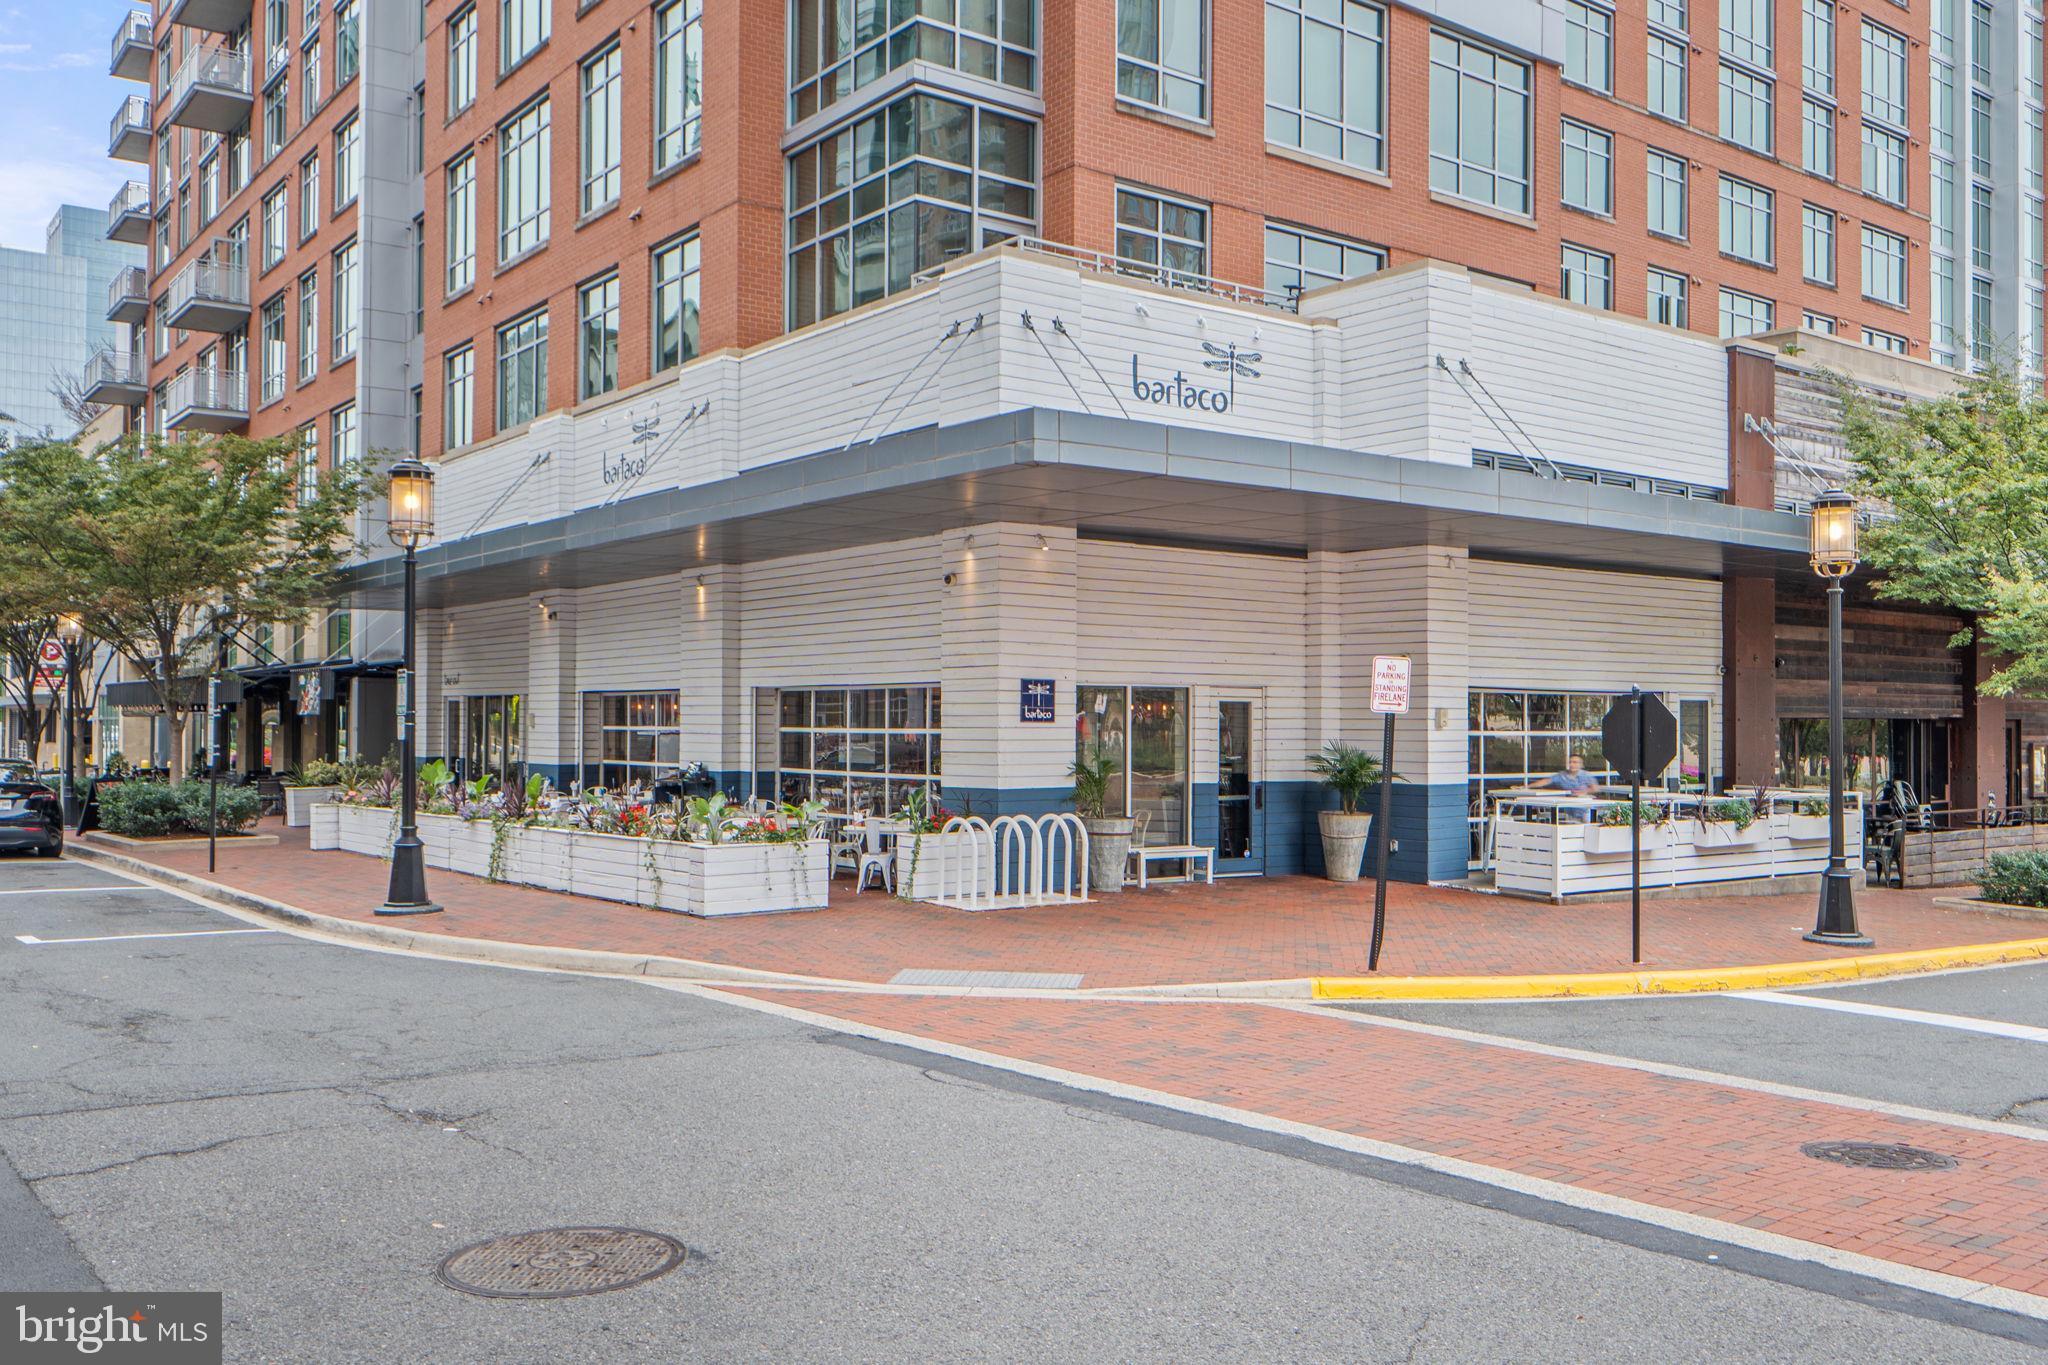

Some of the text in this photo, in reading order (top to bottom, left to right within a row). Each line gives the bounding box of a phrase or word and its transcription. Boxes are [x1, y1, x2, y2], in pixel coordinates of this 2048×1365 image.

[1132, 353, 1229, 413] bartaco
[603, 451, 645, 485] bartaco
[1376, 671, 1406, 680] PARKING
[1374, 684, 1407, 692] STANDING
[1374, 692, 1406, 702] FIRELANE
[1024, 704, 1052, 719] bartaco
